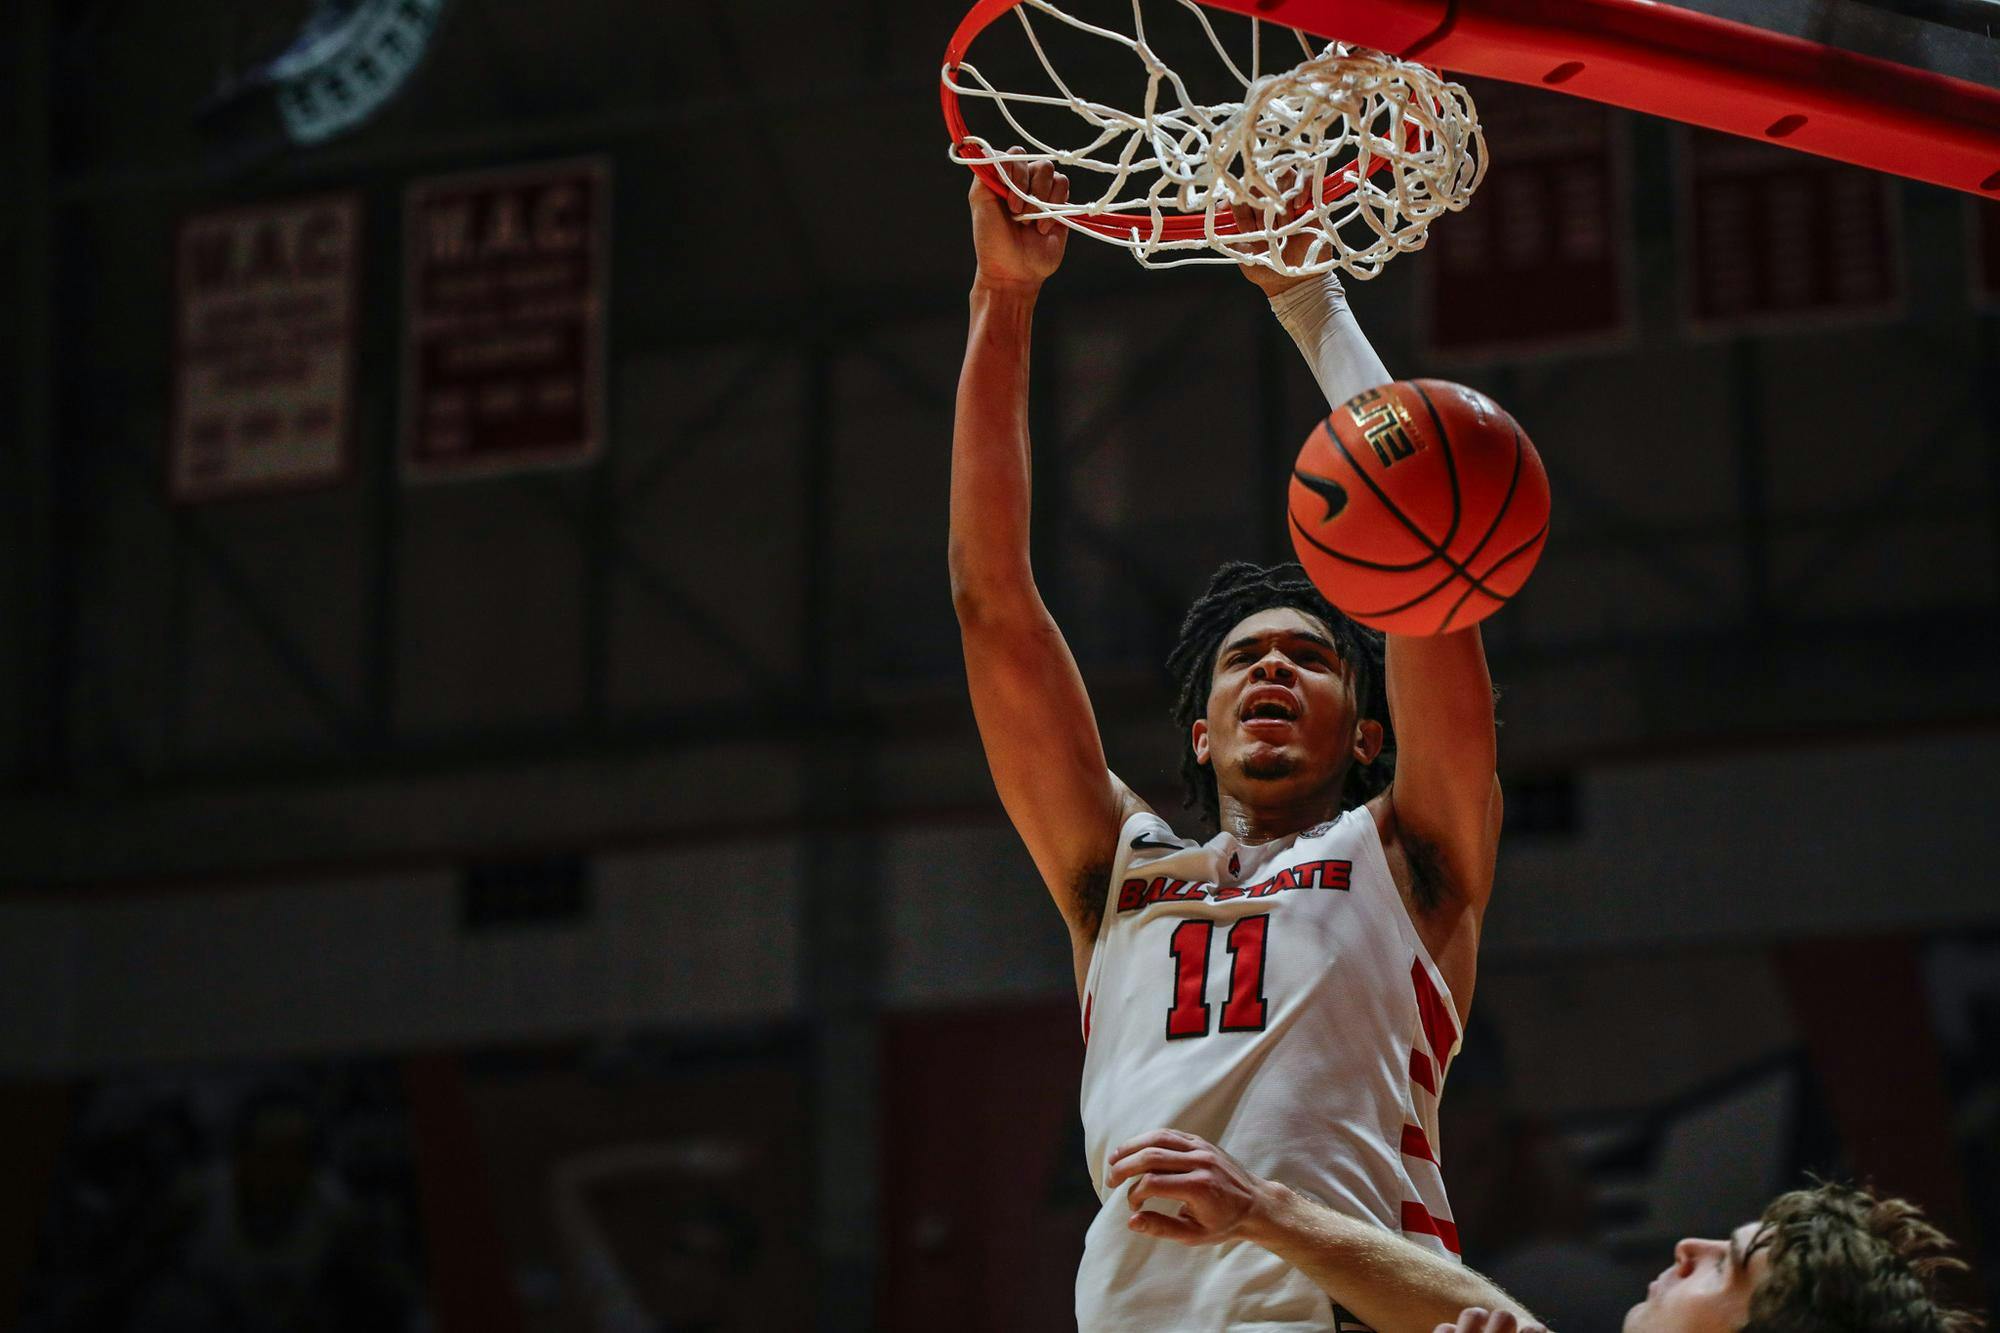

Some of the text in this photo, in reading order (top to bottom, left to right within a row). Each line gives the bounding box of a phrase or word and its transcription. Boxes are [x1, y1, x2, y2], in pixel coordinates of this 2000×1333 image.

[1117, 859, 1352, 913] BALL STATE
[1165, 913, 1270, 1041] 11
